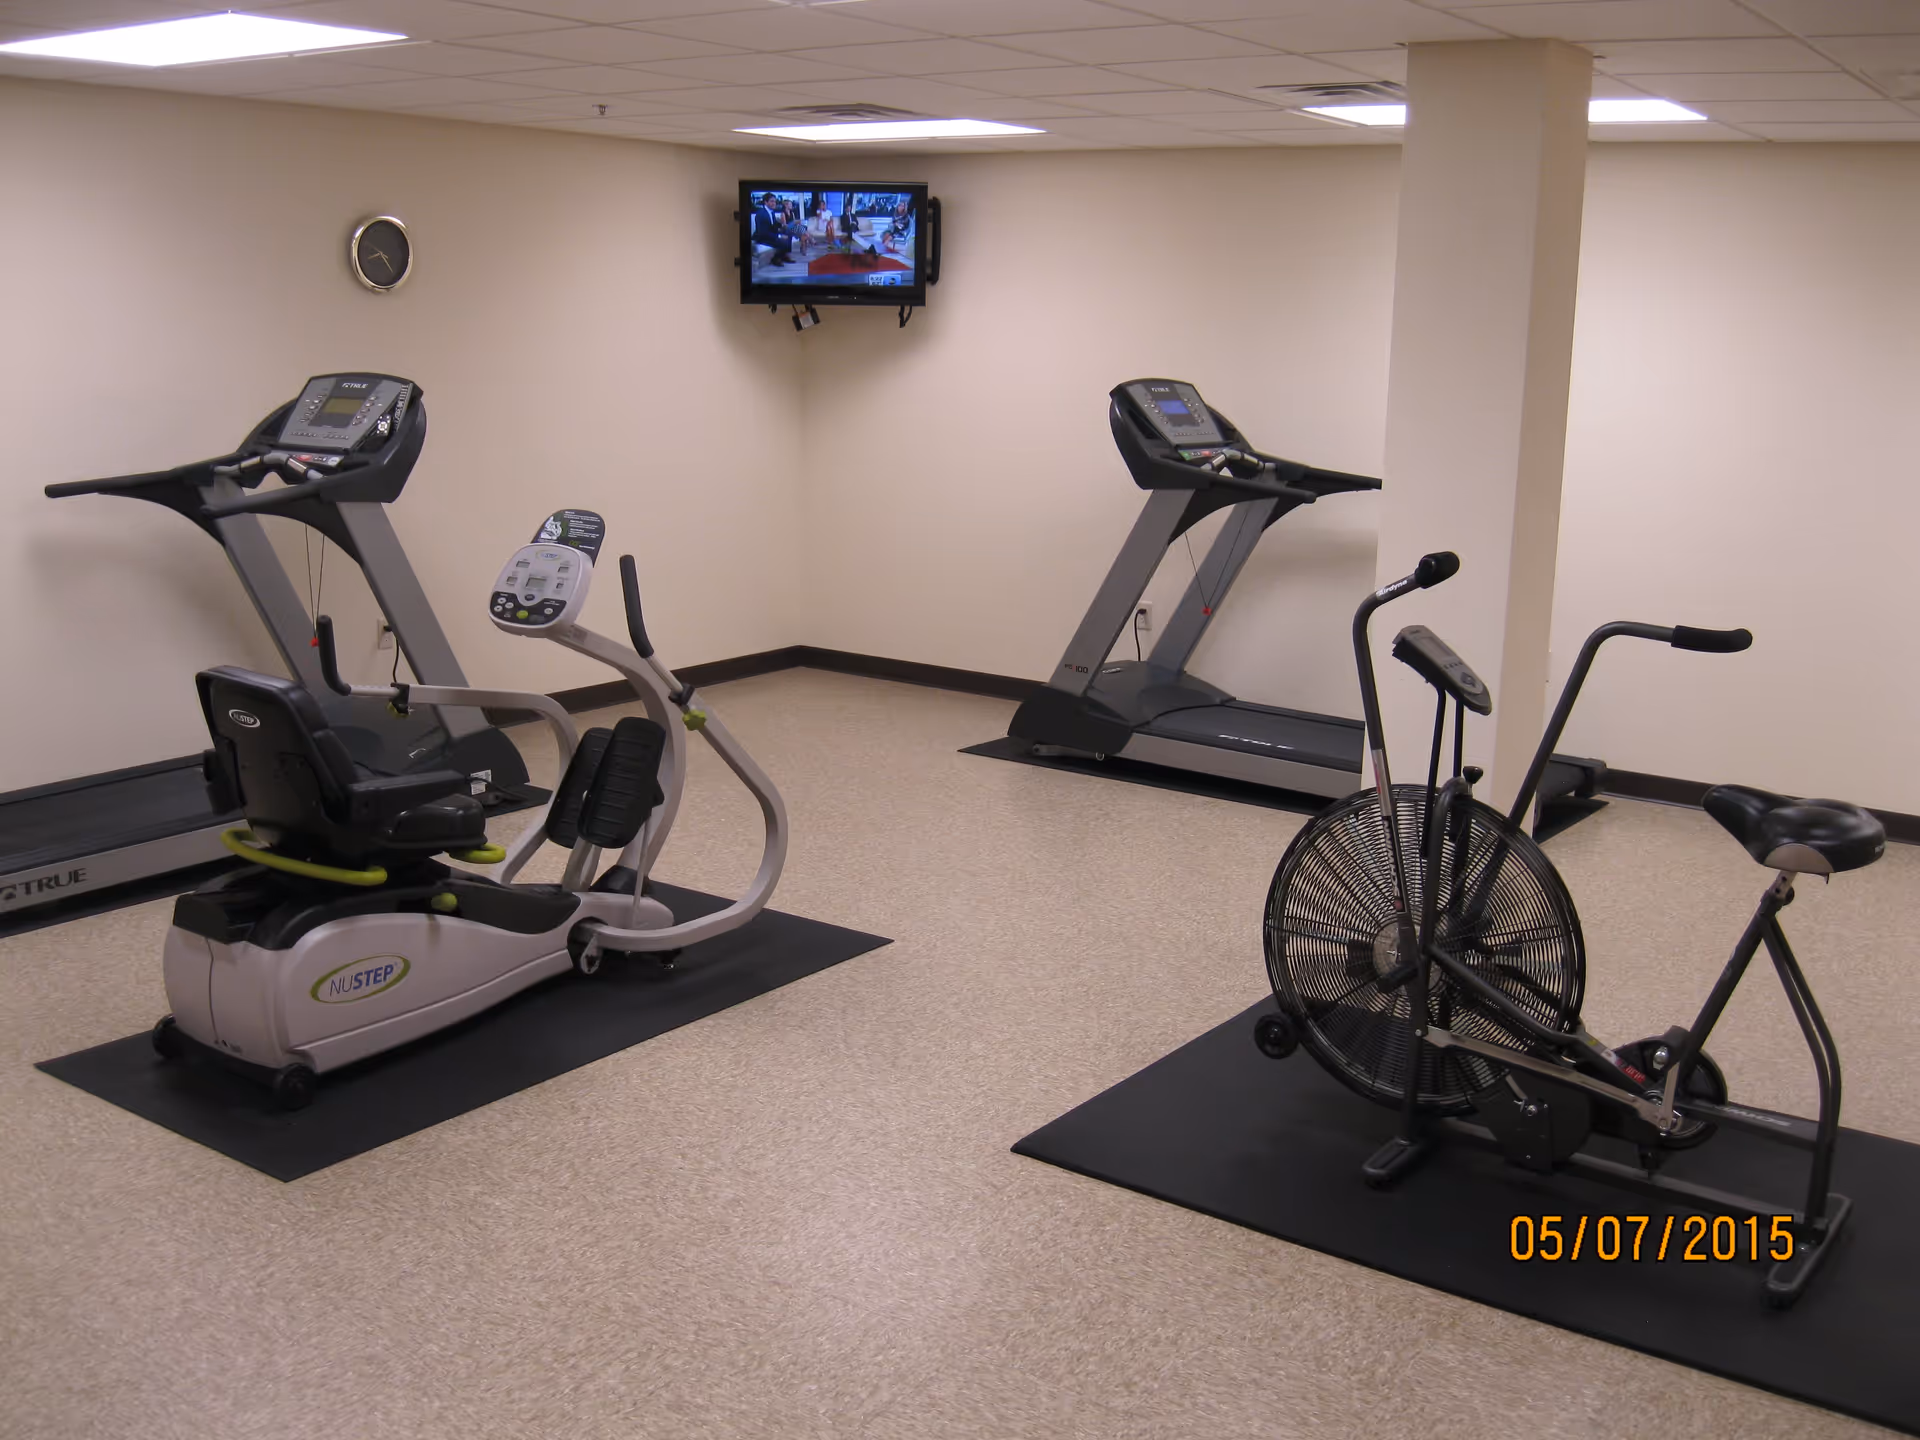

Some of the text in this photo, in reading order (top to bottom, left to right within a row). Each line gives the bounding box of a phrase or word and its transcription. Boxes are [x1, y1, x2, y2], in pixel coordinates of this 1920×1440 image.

[1075, 665, 1089, 674] 100
[1382, 819, 1401, 896] SCHWINN
[18, 867, 87, 896] TRUE
[329, 963, 394, 997] NUSTEP
